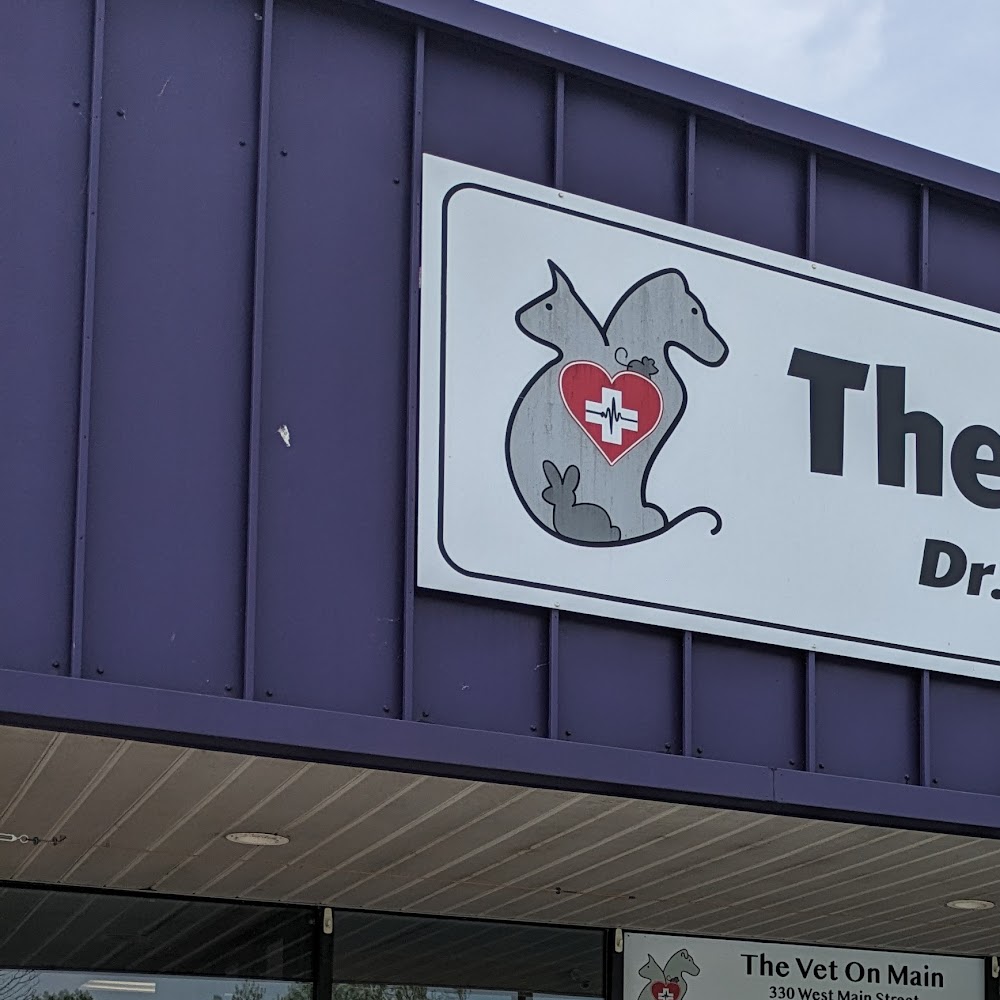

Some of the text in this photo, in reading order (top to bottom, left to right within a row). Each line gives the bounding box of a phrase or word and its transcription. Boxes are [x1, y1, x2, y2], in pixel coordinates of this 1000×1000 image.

[741, 953, 943, 987] The Vet On Main
[770, 986, 795, 999] 330
[798, 988, 833, 1000] West
